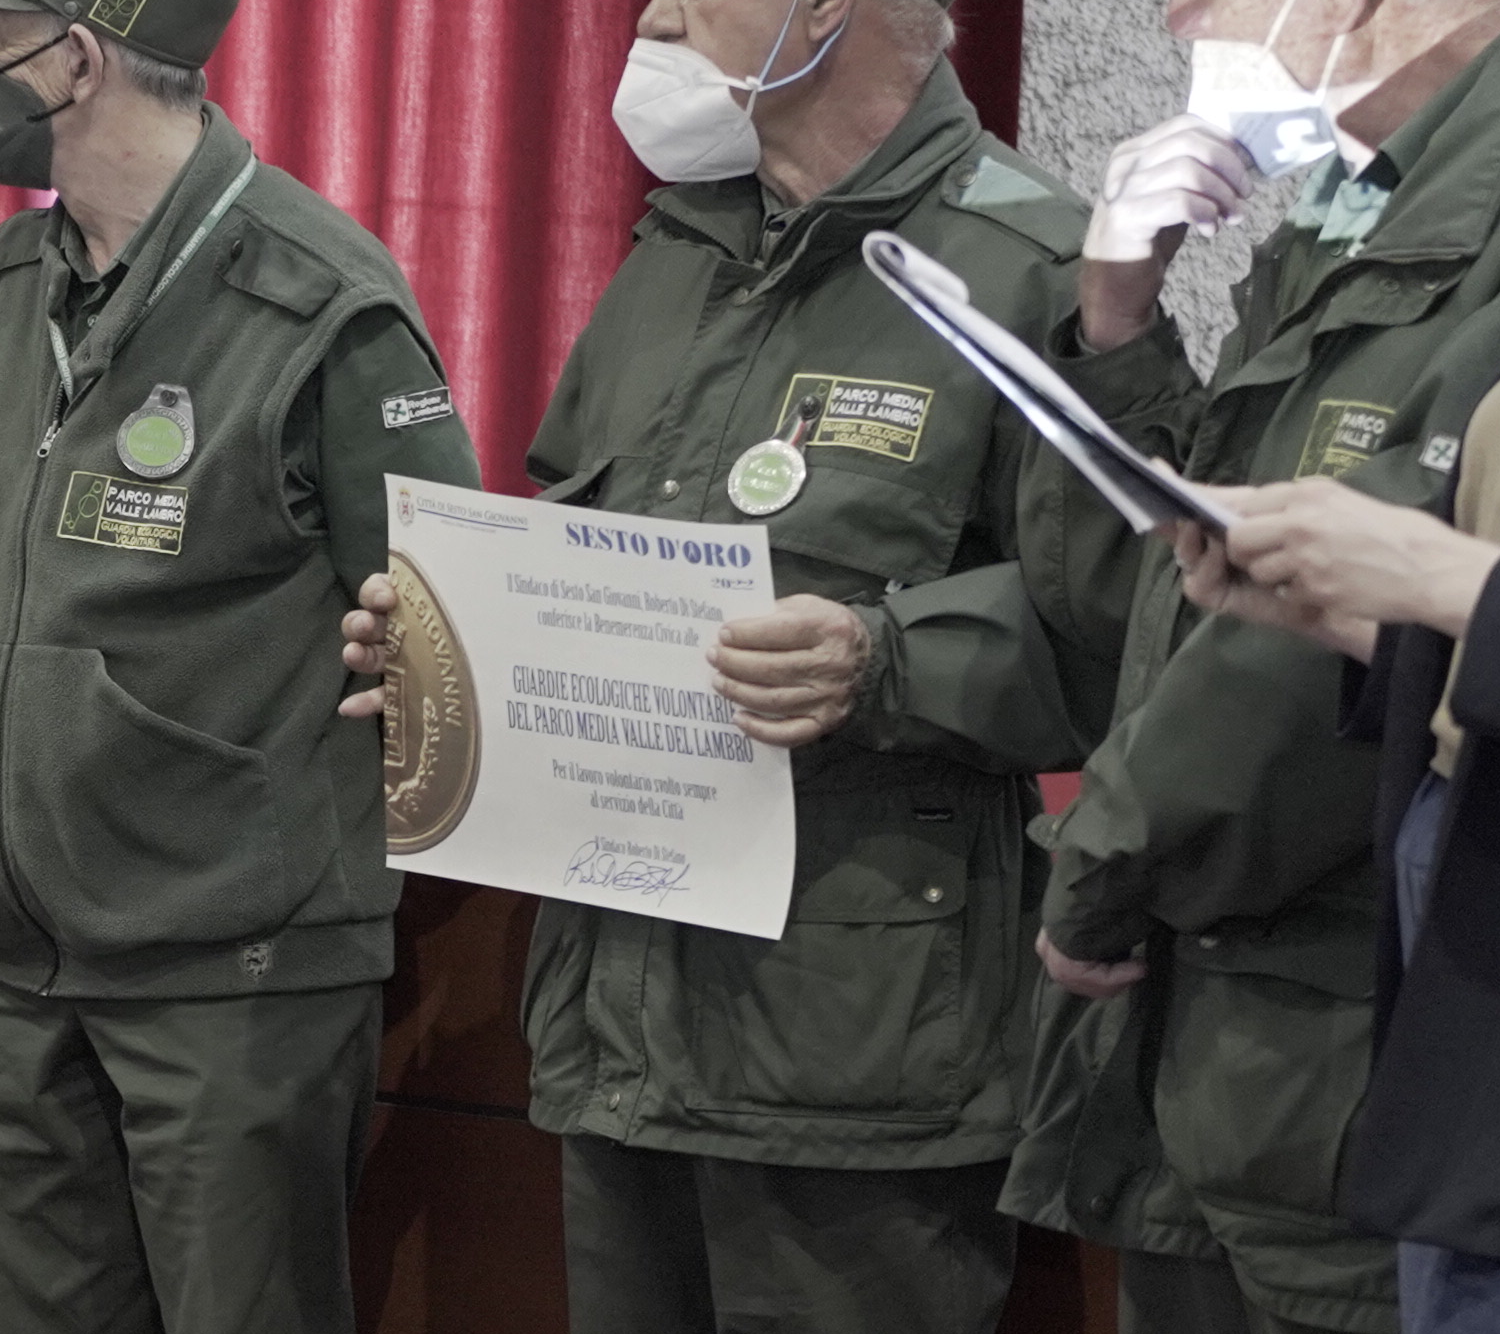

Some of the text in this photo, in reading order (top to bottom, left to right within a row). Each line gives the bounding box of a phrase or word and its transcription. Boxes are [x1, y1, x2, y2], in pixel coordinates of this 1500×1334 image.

[833, 386, 925, 412] PARCO MEDIA
[829, 402, 921, 427] VALLE LAMBRO
[1340, 412, 1387, 434] PARCO
[821, 422, 912, 445] GUARDIA ECOLOGICA
[833, 433, 892, 452] VOLONTARIA
[107, 486, 184, 510] PARCO MEDIA
[106, 501, 184, 523] VALLE LAMBRO
[101, 521, 178, 541] GUARDIA ECOLOGICA
[115, 533, 161, 548] VOLONTARIA
[565, 522, 752, 567] SESTO D'ORO
[514, 574, 548, 597] Sindaco
[550, 579, 559, 598] di
[560, 579, 584, 601] Sesto
[585, 583, 602, 604] San
[644, 591, 678, 616] Roberto
[679, 596, 689, 618] Di
[537, 608, 699, 647] conferisce la Benemerenza Civica alle
[513, 665, 568, 701] GUARDIE
[571, 673, 651, 714] ECOLOGICHE
[507, 700, 754, 763] DEL PARCO MEDIA VALLE DEL LAMBRO
[552, 759, 717, 803] Per il lavoro volontario svolto sempre
[590, 790, 684, 820] al servizio della Città
